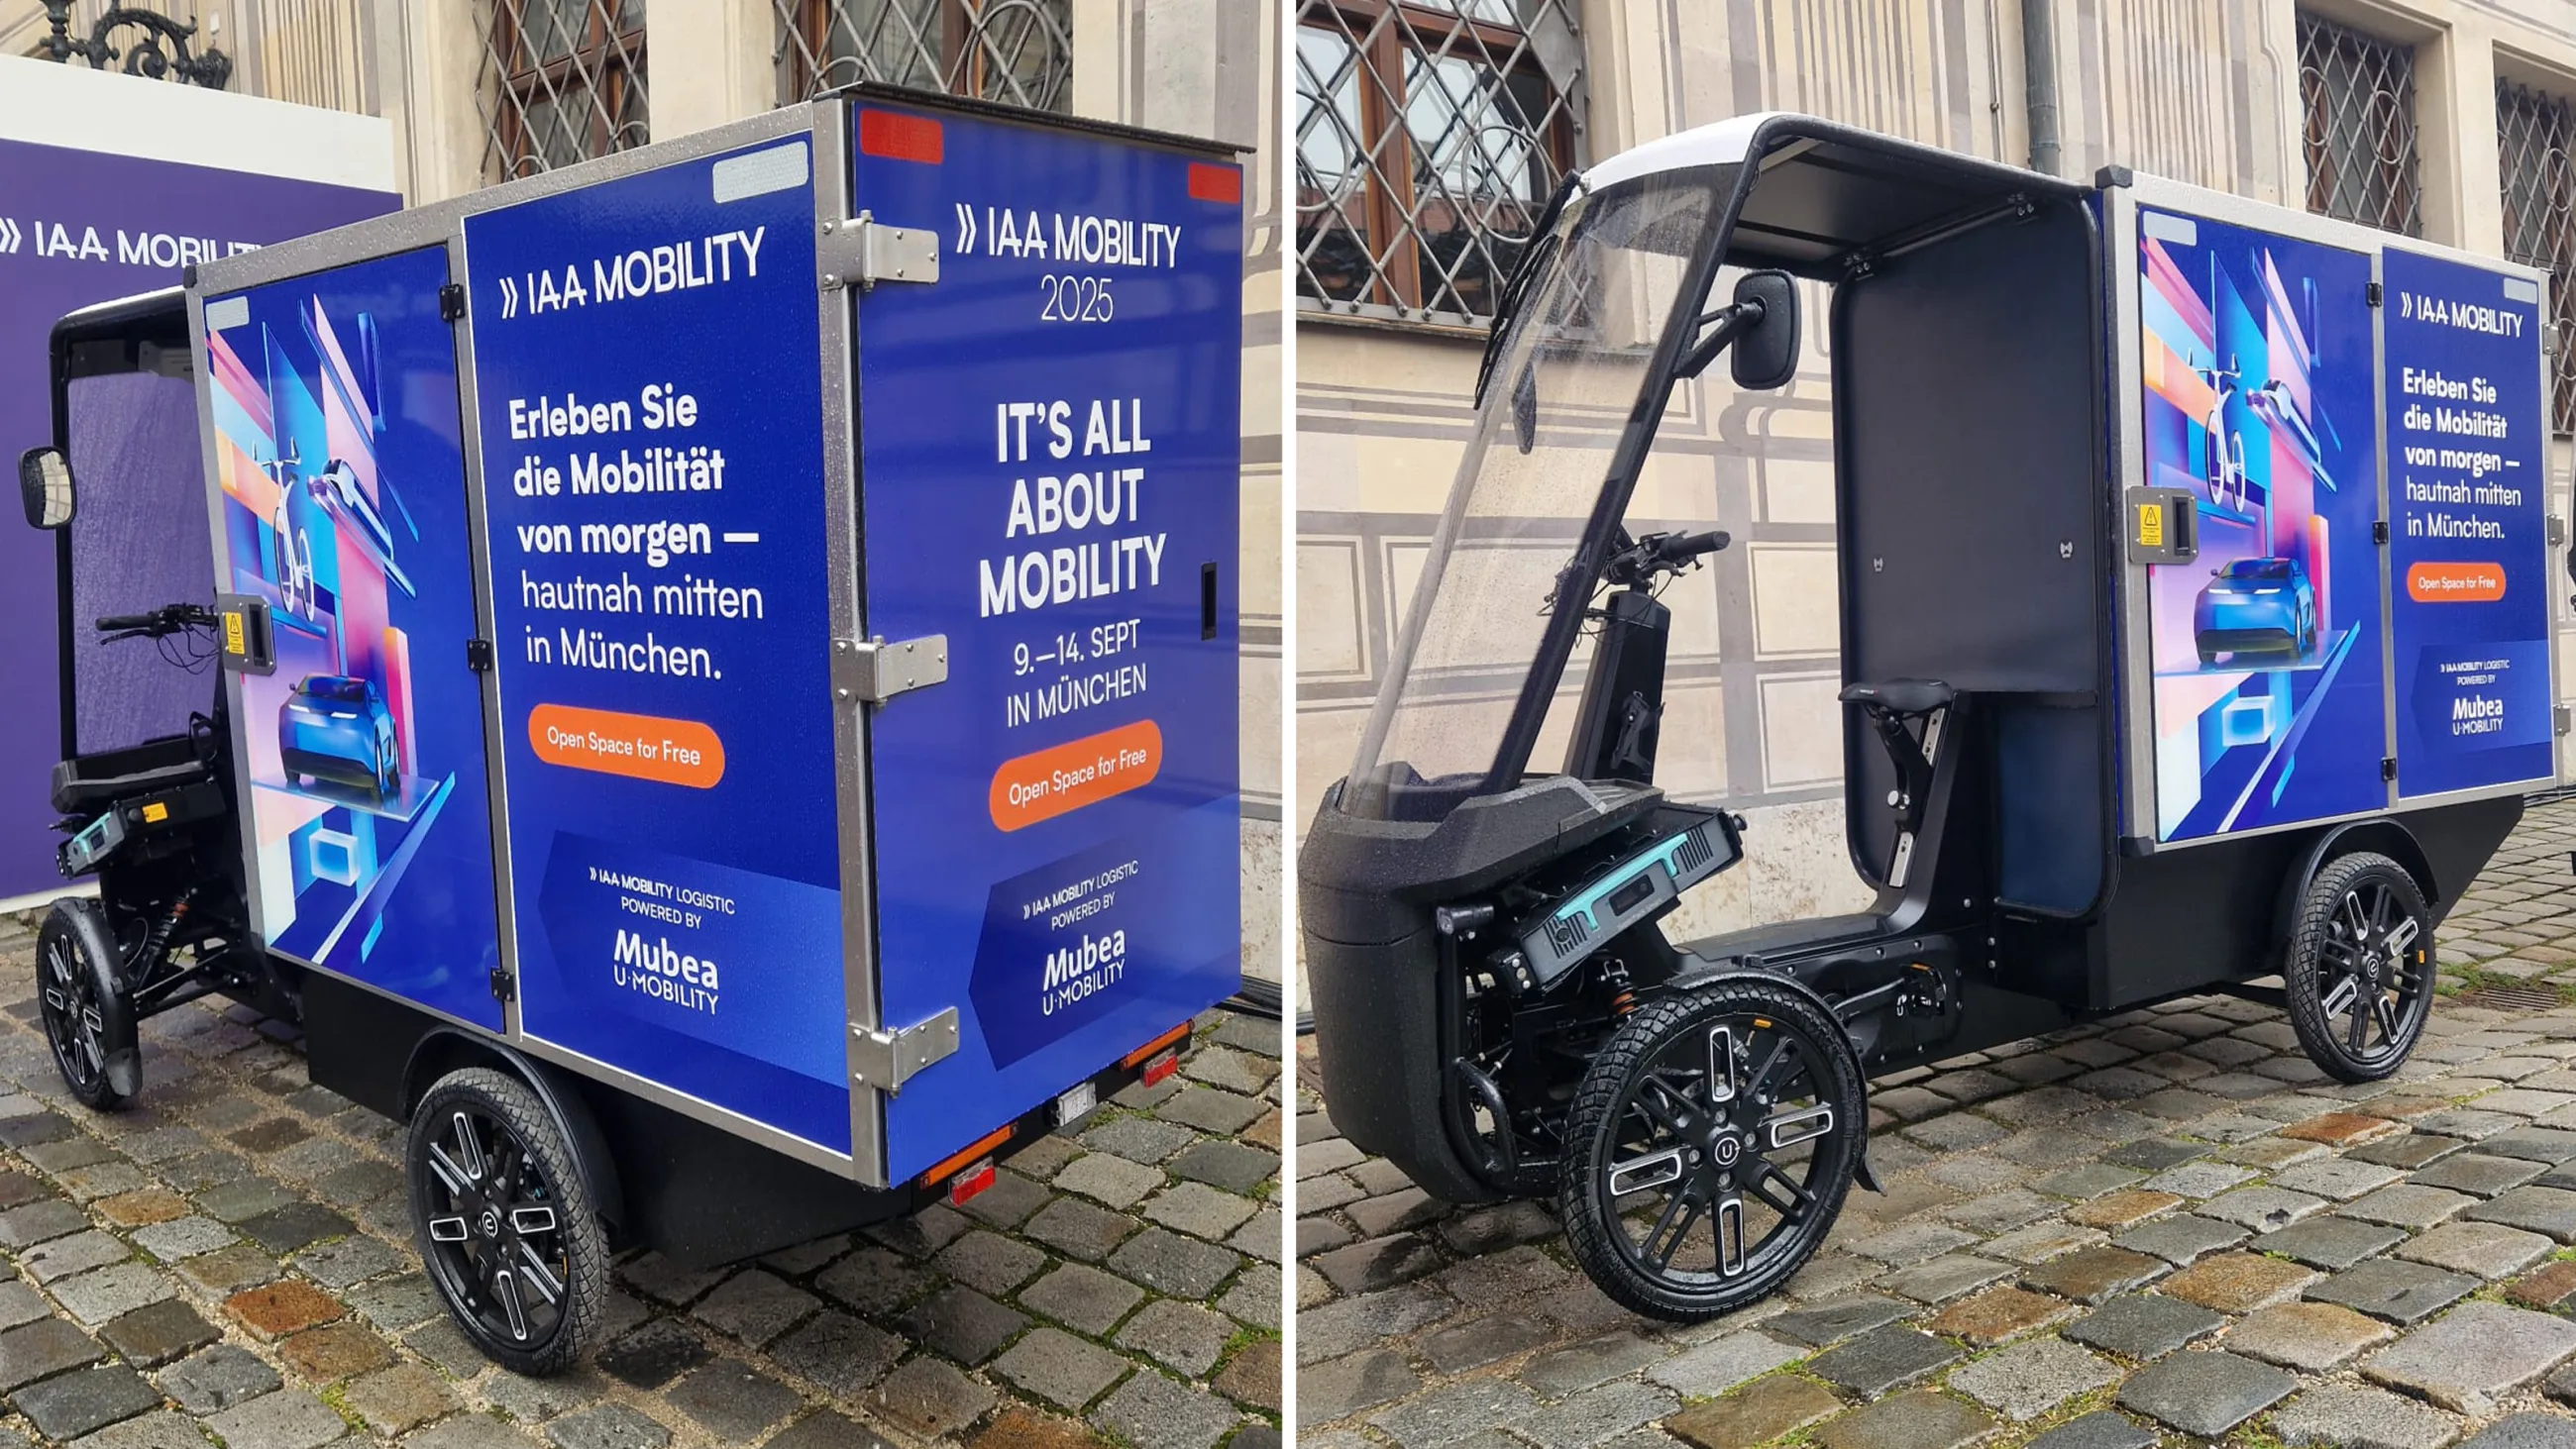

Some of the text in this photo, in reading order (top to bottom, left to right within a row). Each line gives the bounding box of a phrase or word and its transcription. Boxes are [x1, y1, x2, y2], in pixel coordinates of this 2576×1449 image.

[35, 221, 263, 268] IAA MOBIL
[988, 206, 1181, 268] IAA MOBILITY
[527, 226, 765, 314] IAA MOBILITY
[1040, 273, 1114, 323] 2025
[2416, 294, 2523, 338] IAA MOBILITY
[2403, 366, 2497, 404] Erleben Sie
[508, 382, 698, 440] Erleben Sie
[997, 398, 1151, 463] IT’S ALL
[2404, 403, 2508, 439] die Mobilität
[513, 446, 725, 496] die Mobilität
[2405, 446, 2435, 466] von
[2440, 450, 2502, 477] morgen
[1006, 467, 1144, 539] ABOUT
[2406, 475, 2522, 507] hautnah mitten
[517, 524, 572, 553] von
[581, 520, 711, 568] morgen
[2407, 511, 2506, 540] in München.
[522, 569, 763, 619] hautnah mitten
[979, 533, 1167, 618] MOBILITY
[2417, 575, 2496, 592] Open Space for Free
[525, 625, 721, 679] in München.
[1091, 618, 1140, 659] SEPT
[2446, 660, 2511, 673] IAA MOBILITY LOGISTIC
[2457, 673, 2496, 685] POWERED BY
[1007, 662, 1147, 728] IN MÜNCHEN
[2452, 693, 2504, 721] Mubea
[547, 726, 700, 766] Open Space for Free
[1009, 748, 1147, 809] Open Space for Free
[598, 869, 735, 915] IAA MOBILITY LOGISTIC
[1032, 860, 1138, 917] IAA MOBILITY LOGISTIC
[1051, 891, 1116, 932] POWERED BY
[621, 896, 701, 929] POWERED BY
[613, 929, 719, 990] Mubea
[1043, 929, 1126, 991] Mubea
